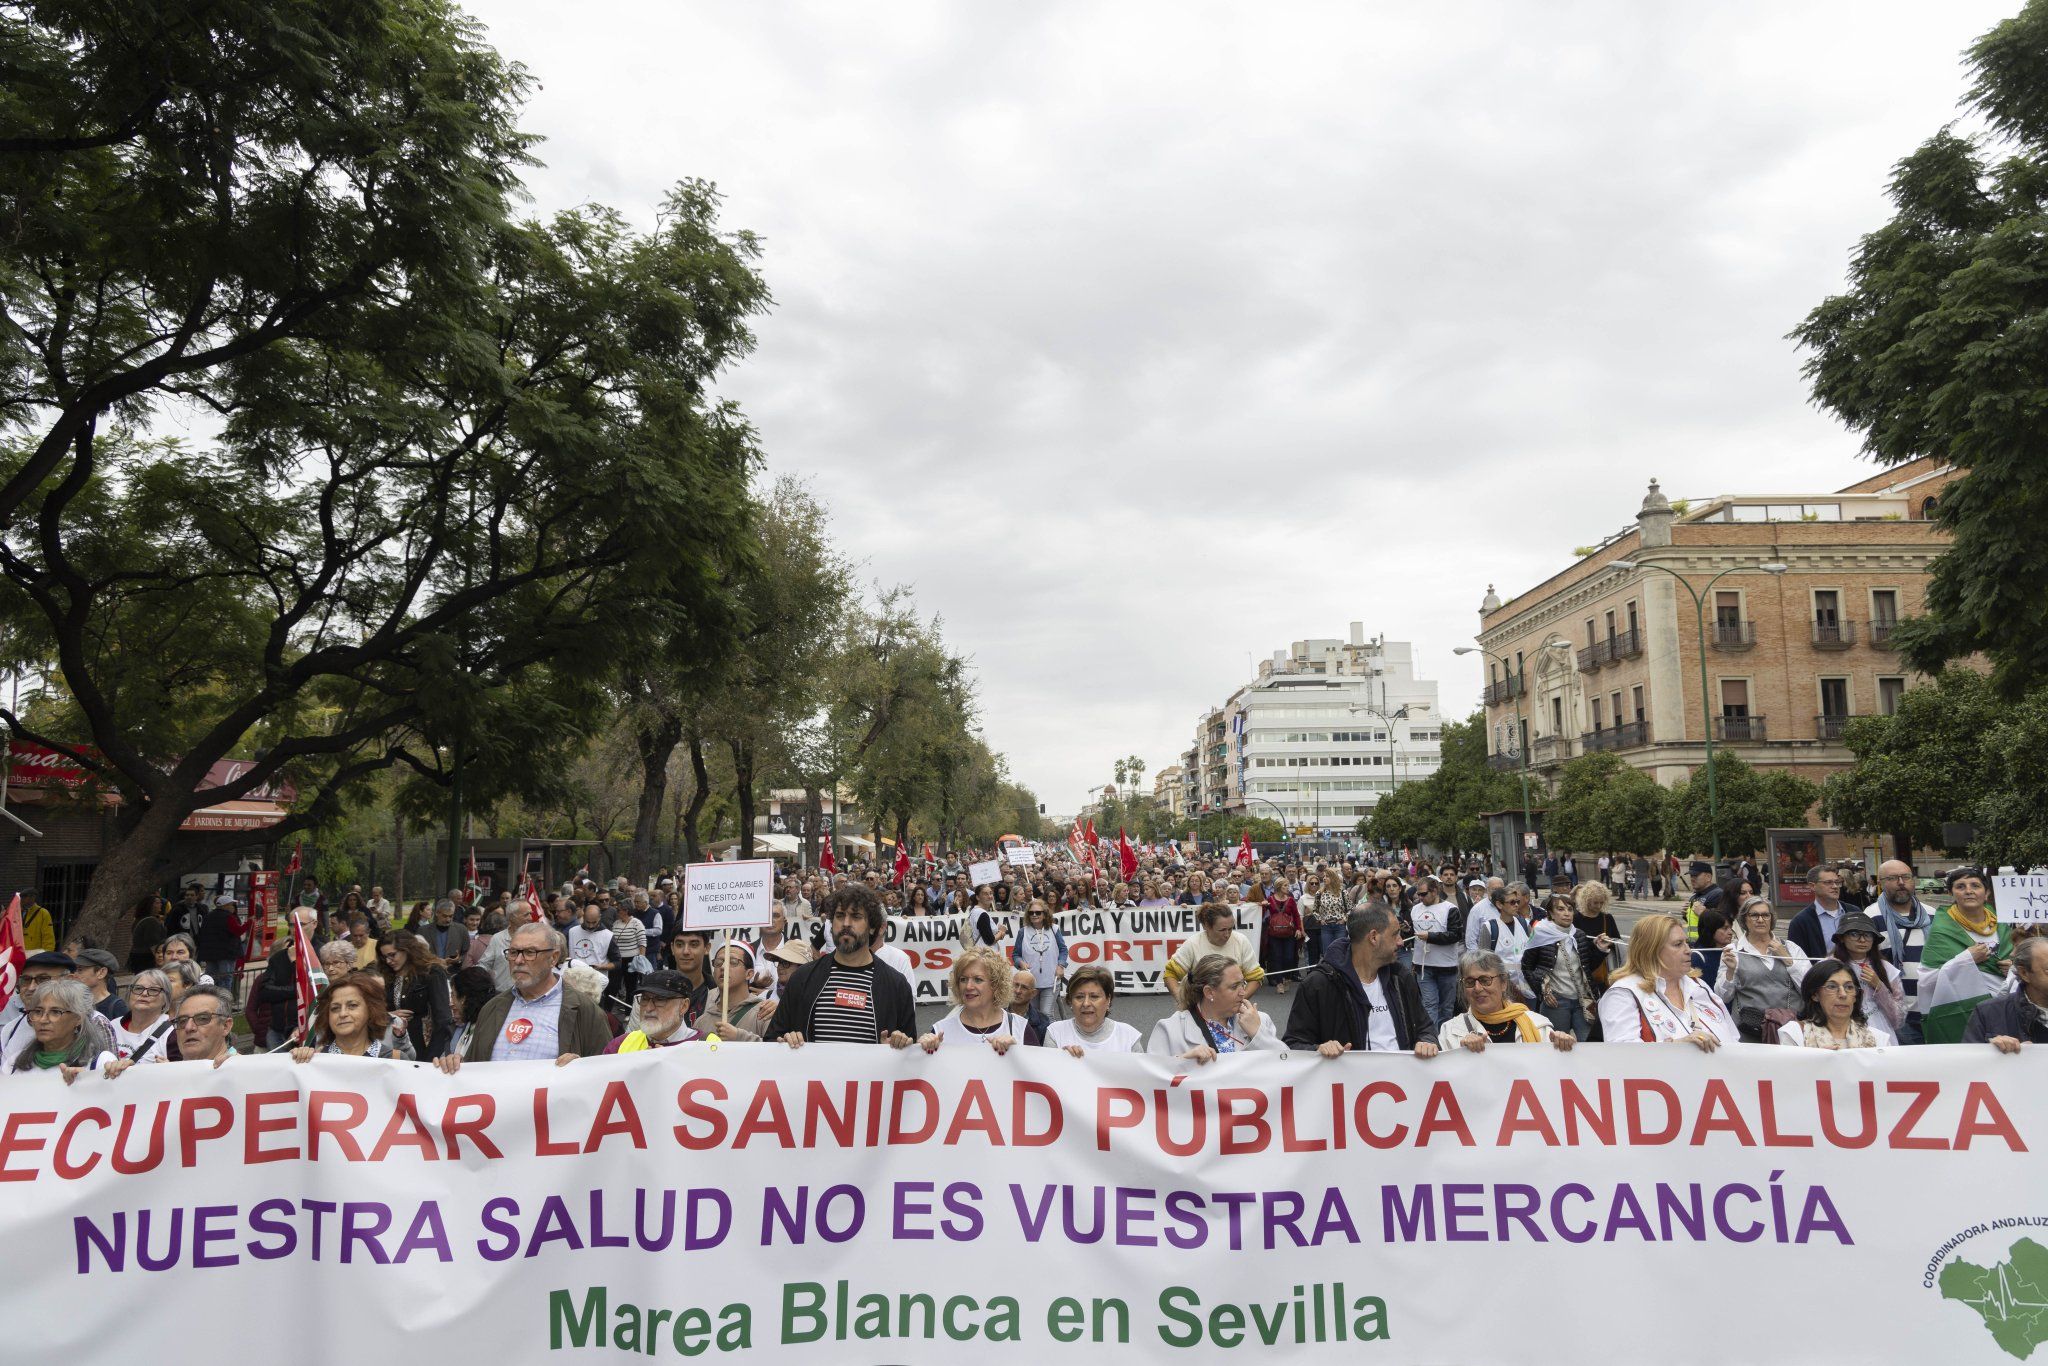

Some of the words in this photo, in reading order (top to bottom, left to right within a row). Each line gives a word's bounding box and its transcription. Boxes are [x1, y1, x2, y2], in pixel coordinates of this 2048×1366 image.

[195, 817, 222, 827] JARDINES
[224, 818, 233, 827] DE
[234, 819, 261, 828] MURILLO
[691, 883, 703, 891] NO
[704, 882, 716, 890] ME
[717, 881, 728, 890] LO
[729, 880, 764, 889] CAMBIES
[2002, 877, 2048, 887] SEVIL
[698, 893, 738, 903] NECESITO
[746, 892, 755, 900] MI
[707, 903, 745, 913] MÉDICO/A
[1110, 911, 1124, 934] Y
[508, 1023, 532, 1034] UGT
[533, 1081, 648, 1157] LA
[673, 1078, 1064, 1151] SANIDAD
[1096, 1075, 1475, 1157] PÚBLICA
[1497, 1078, 2028, 1153] ANDALUZA
[74, 1198, 454, 1275] NUESTRA
[476, 1187, 733, 1262] SALUD
[760, 1183, 865, 1246] NO
[892, 1181, 984, 1242] ES
[1010, 1183, 1360, 1251] VUESTRA
[1381, 1169, 1853, 1245] MERCANCÍA
[1923, 1223, 1989, 1289] COORDINADORA
[1992, 1216, 2048, 1231] ANDALUZ
[548, 1286, 753, 1358] Marea
[780, 1280, 1021, 1345] Blanca
[1046, 1297, 1130, 1345] en
[1157, 1281, 1391, 1349] Sevilla
